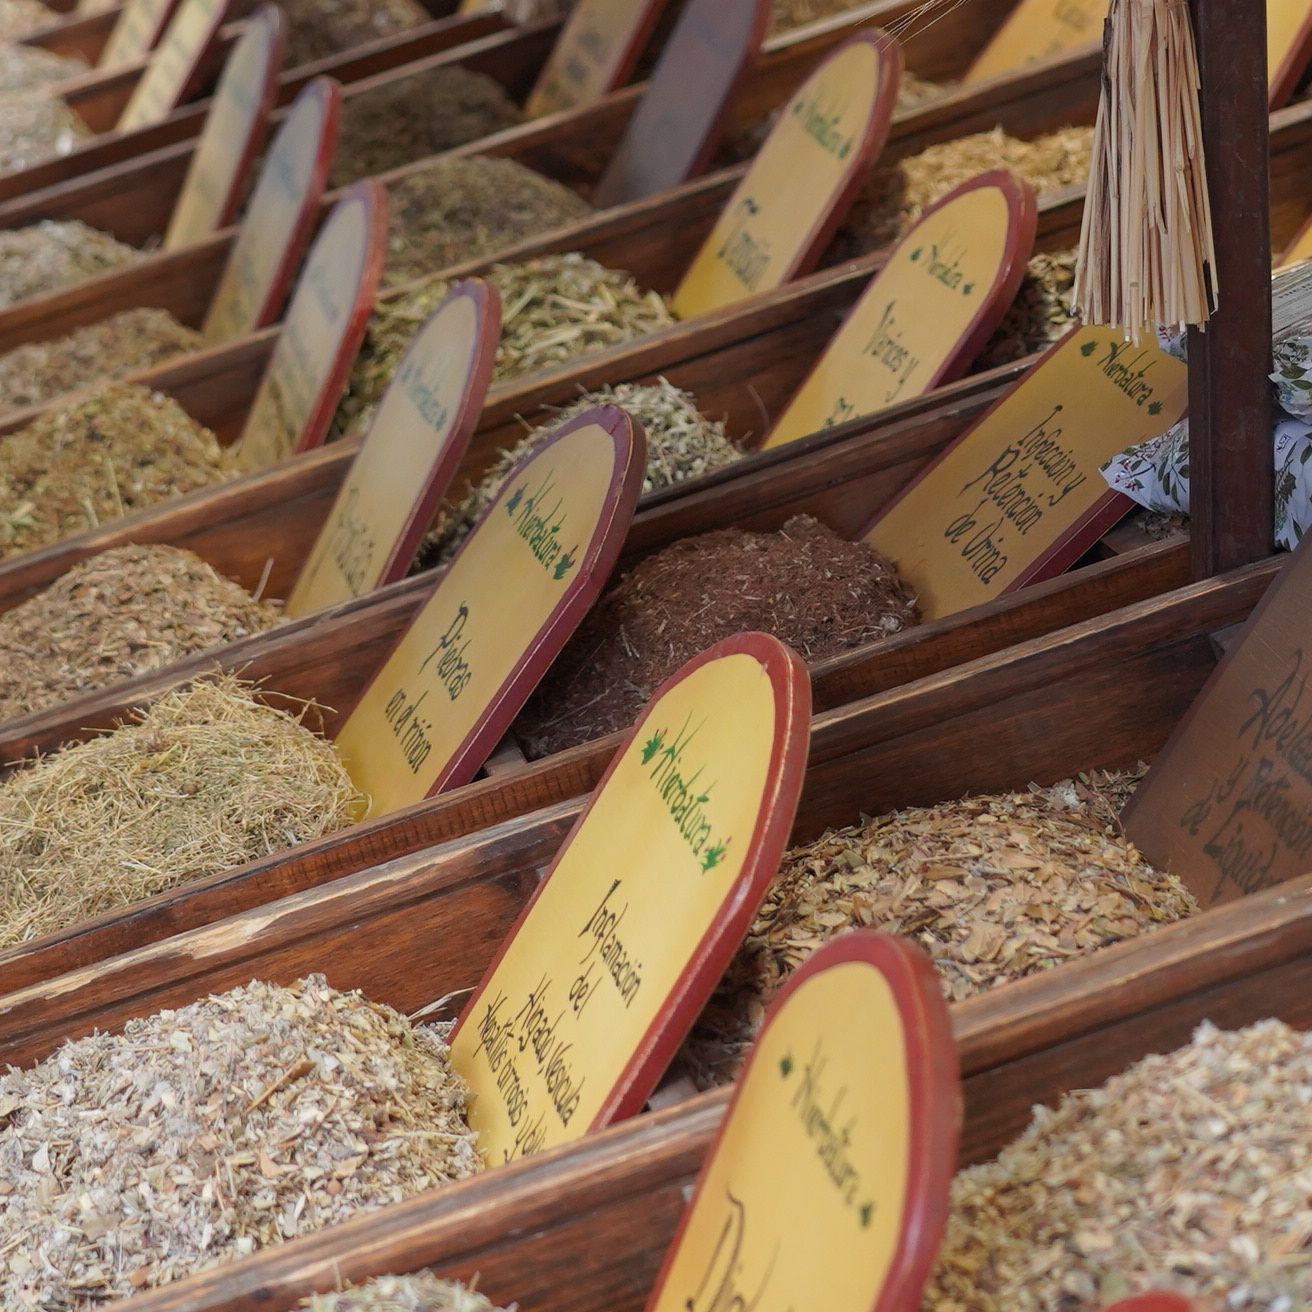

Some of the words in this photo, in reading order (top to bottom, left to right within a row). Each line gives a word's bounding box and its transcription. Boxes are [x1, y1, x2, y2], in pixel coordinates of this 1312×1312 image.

[943, 499, 986, 545] de
[960, 514, 1010, 585] Orina
[420, 599, 473, 703] Piedras
[649, 710, 715, 857] Hierbatura
[568, 962, 603, 1021] del
